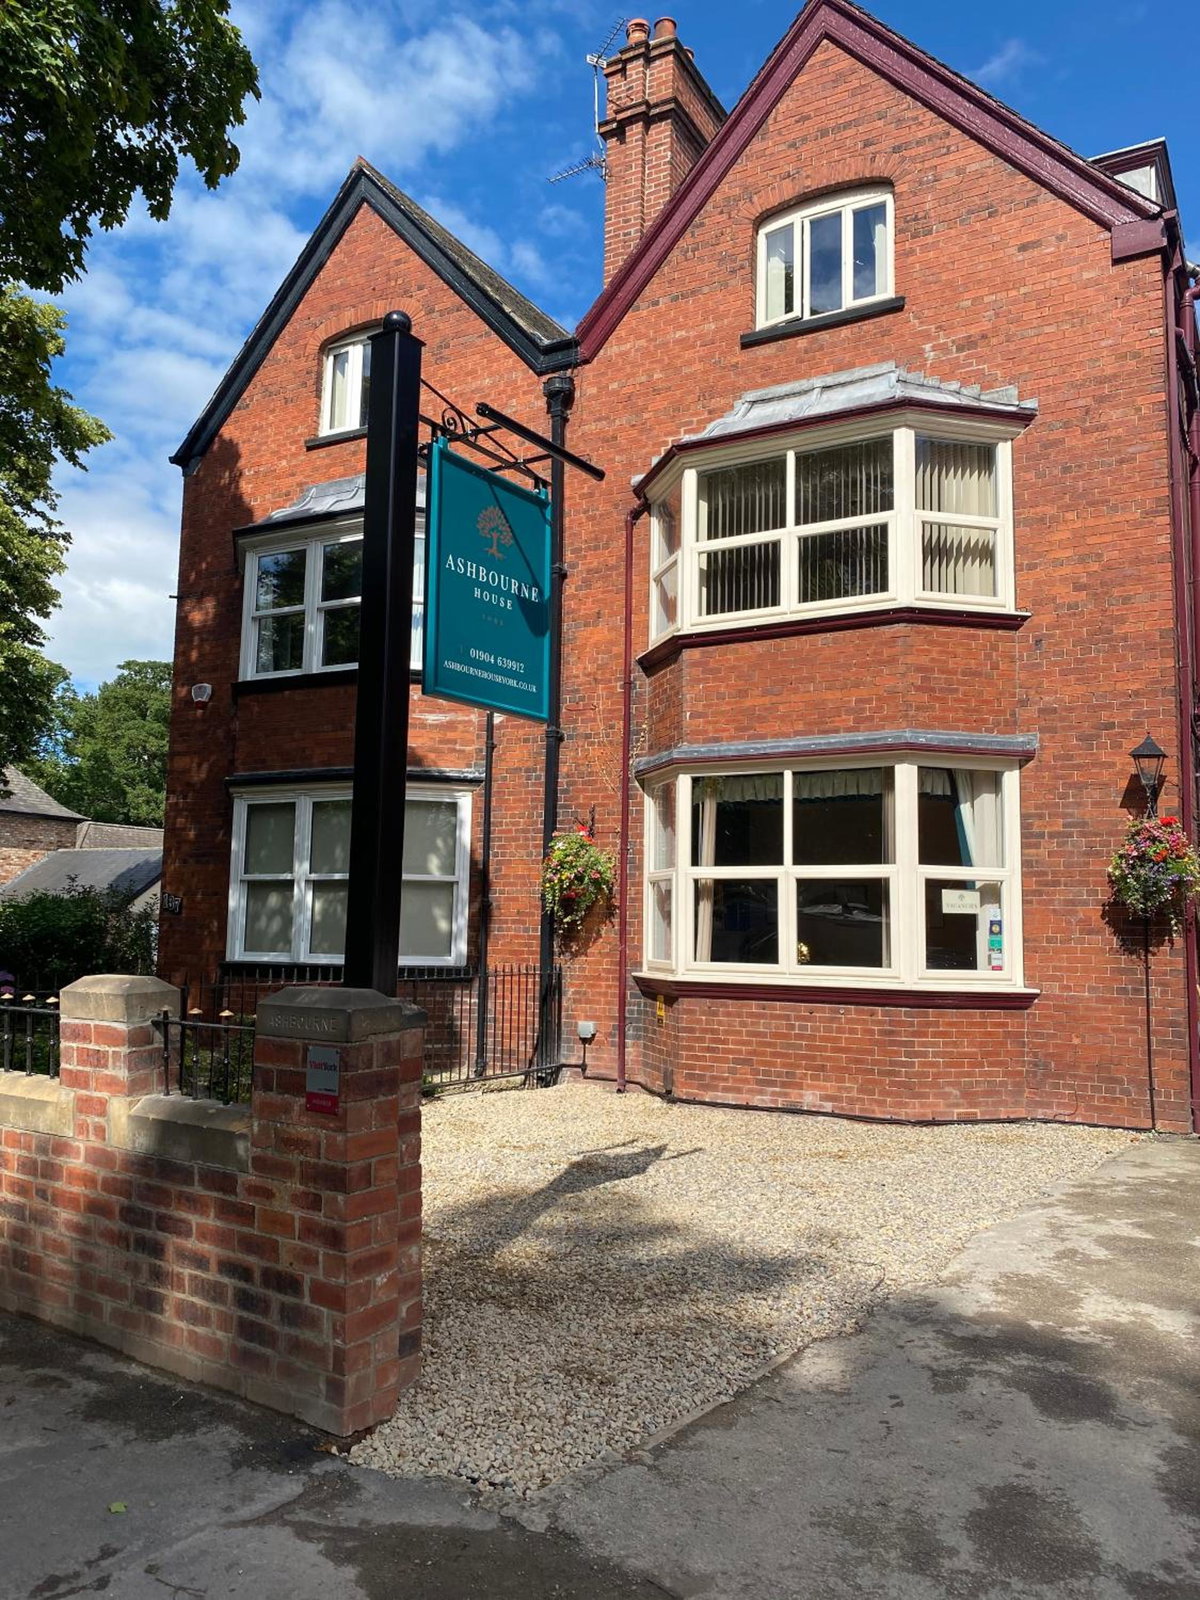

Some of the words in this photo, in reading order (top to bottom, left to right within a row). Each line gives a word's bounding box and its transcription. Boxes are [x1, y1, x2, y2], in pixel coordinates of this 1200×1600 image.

[445, 553, 539, 603] ASHBOURNE
[474, 587, 513, 610] HOUSE
[469, 647, 495, 665] 01904
[497, 656, 525, 673] 639912
[443, 660, 537, 693] ASHBOURNEHOUSEYORK.CO.UK
[269, 1014, 338, 1032] ASHBOURNE
